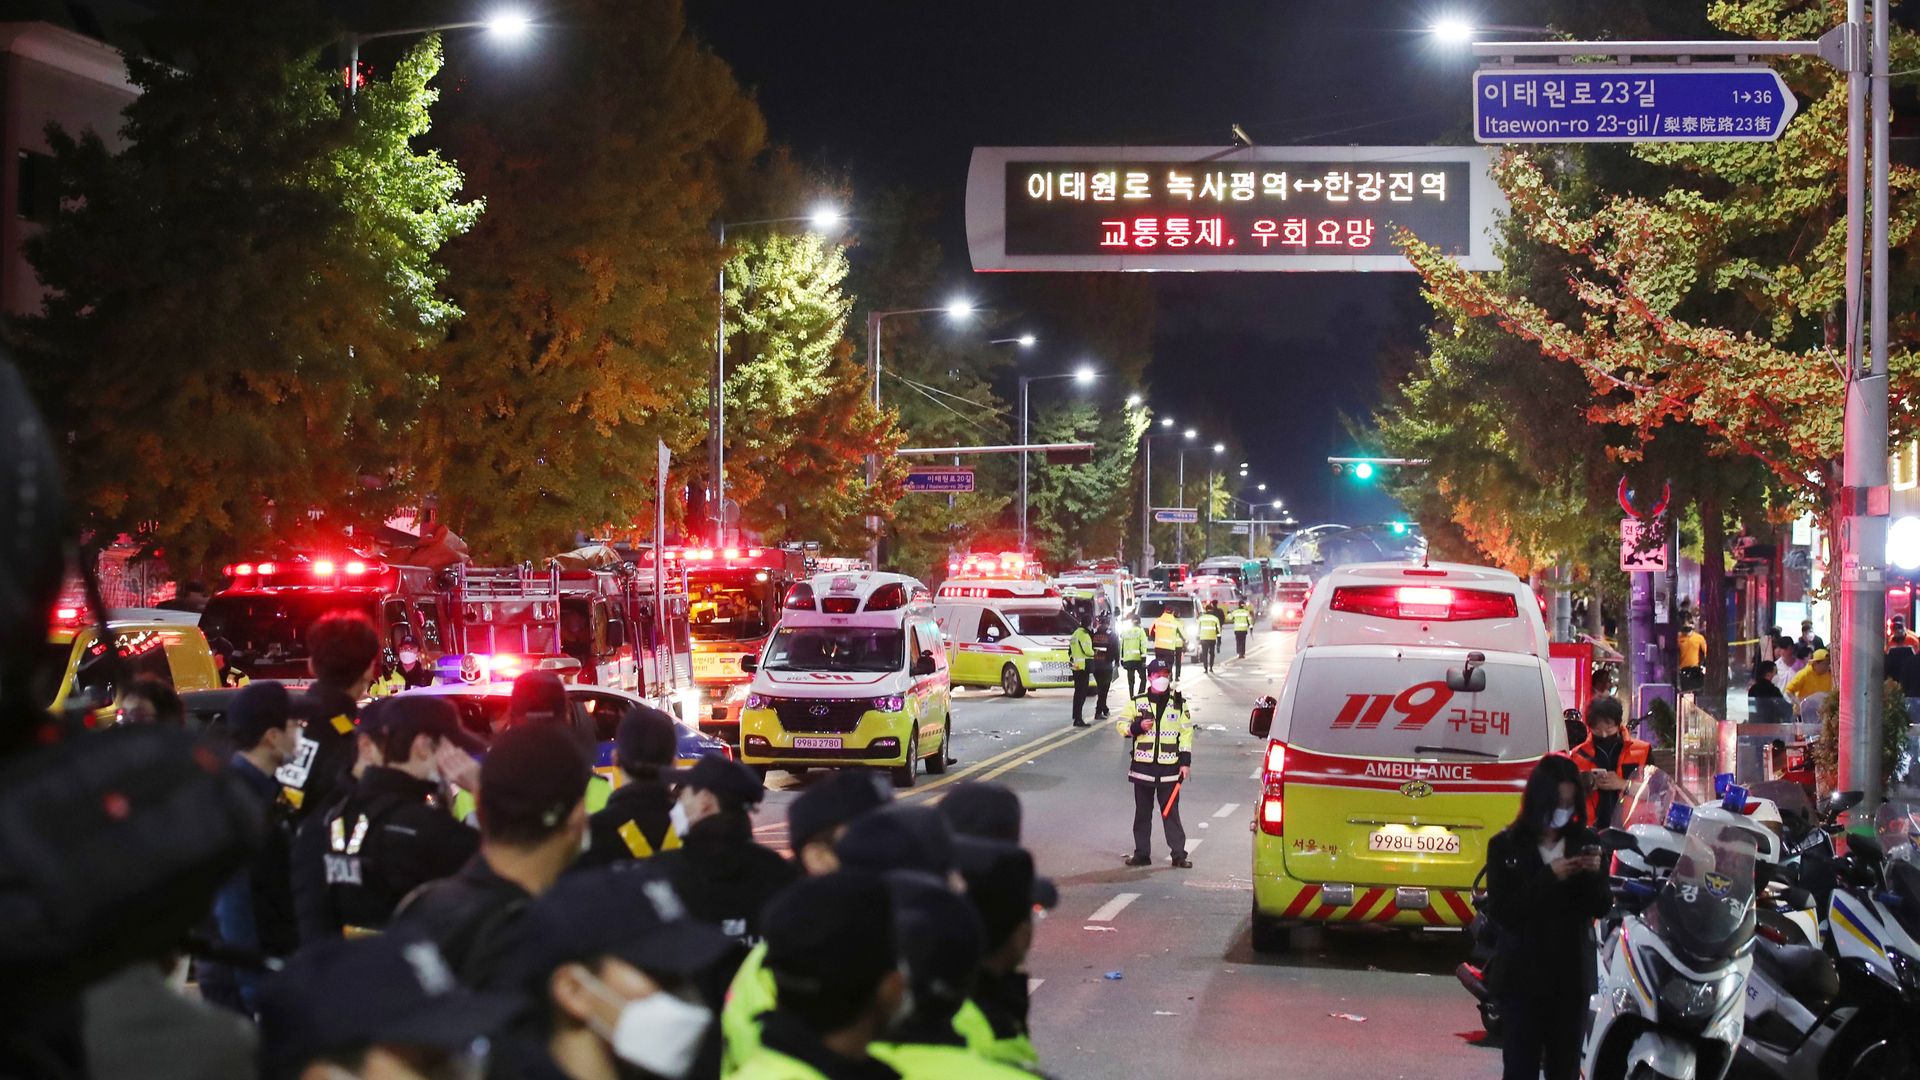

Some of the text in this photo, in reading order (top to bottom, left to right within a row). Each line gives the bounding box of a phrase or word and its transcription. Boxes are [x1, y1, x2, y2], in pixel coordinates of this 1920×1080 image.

[1485, 115, 1590, 133] Itaewon-ro
[1596, 113, 1649, 136] 23-gil
[1663, 115, 1772, 133] 梨泰院路23街
[1027, 171, 1151, 201] 이태원로
[1329, 680, 1454, 731] 119
[1447, 708, 1510, 736] 구급대
[819, 739, 839, 748] 2780
[1364, 762, 1473, 780] AMBULANCE
[1416, 836, 1455, 851] 5026
